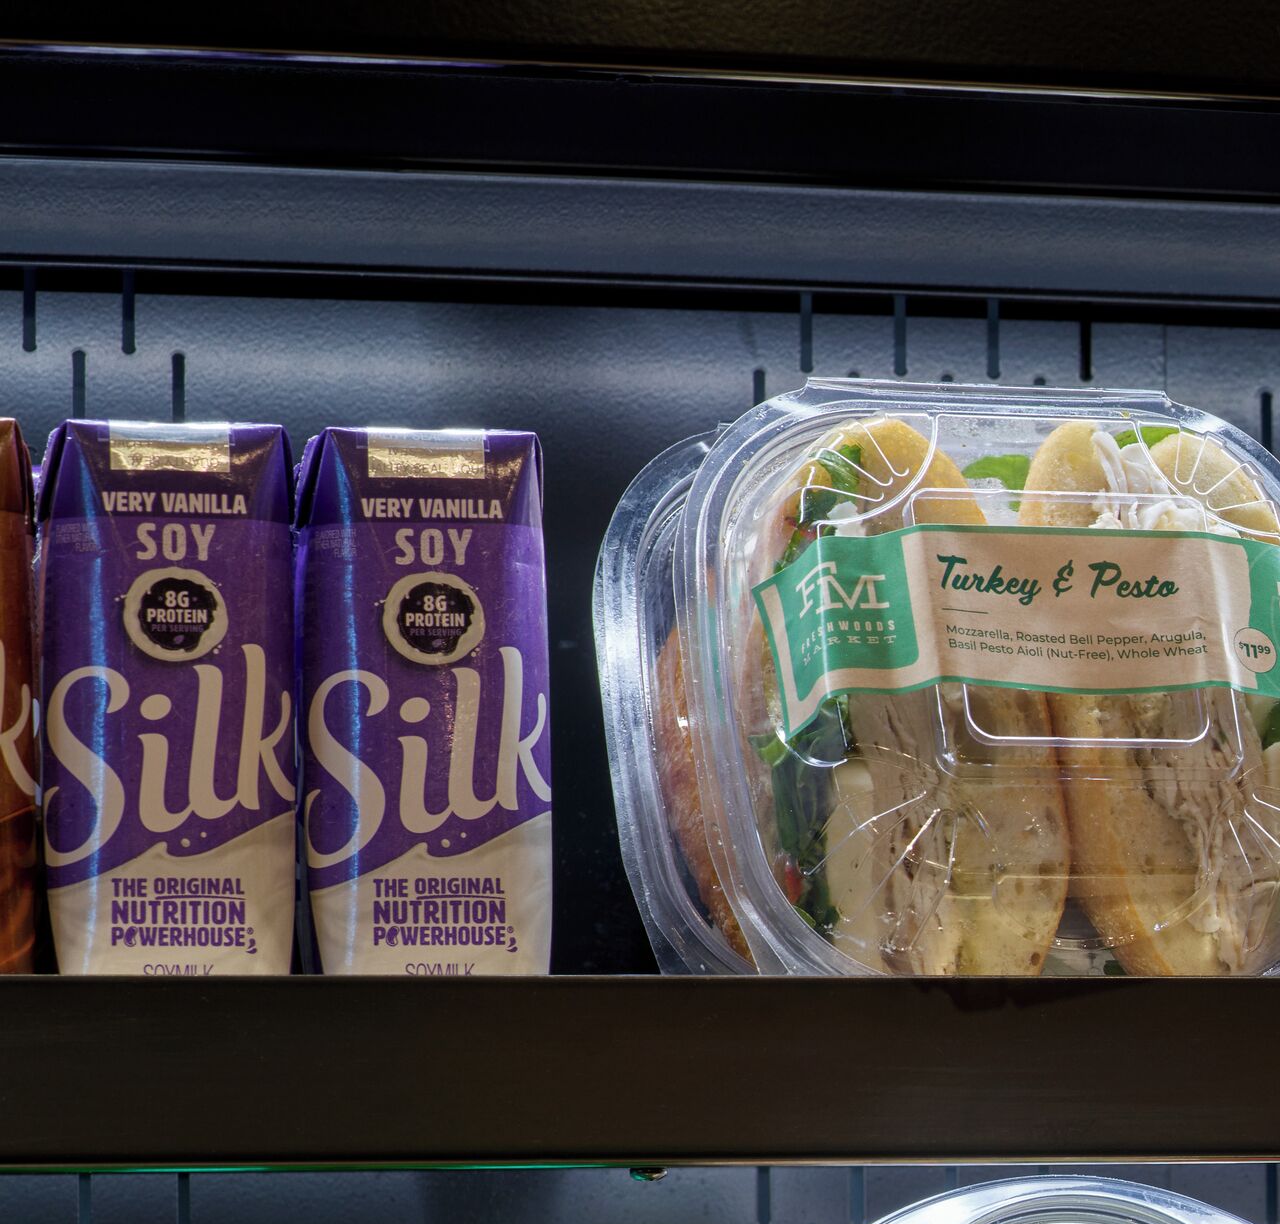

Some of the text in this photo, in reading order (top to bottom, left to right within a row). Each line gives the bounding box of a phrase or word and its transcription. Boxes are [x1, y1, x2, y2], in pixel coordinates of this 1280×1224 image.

[102, 491, 247, 515] VERY VANILLA
[361, 497, 504, 519] VERY VANILLA
[136, 522, 216, 561] SOY
[395, 528, 472, 566] SOY
[796, 561, 890, 619] FM
[937, 554, 1180, 606] Turkey & Pesto
[164, 591, 189, 607] 8G
[423, 595, 447, 612] 8G
[146, 607, 208, 624] PROTEIN
[405, 611, 465, 628] PROTEIN
[801, 620, 896, 655] FRESHWOODS
[946, 624, 1206, 649] Mozzarella, Roasted Bell Pepper, Arugula,
[948, 638, 1208, 662] Basil Pesto Aioli (Nut-Free), Whole Wheat
[44, 644, 295, 868] Silk
[306, 646, 551, 869] Silk
[111, 877, 245, 898] THE ORIGINAL
[373, 877, 504, 898] THE ORIGINAL
[111, 900, 246, 925] NUTRITION
[373, 900, 505, 925] NUTRITION
